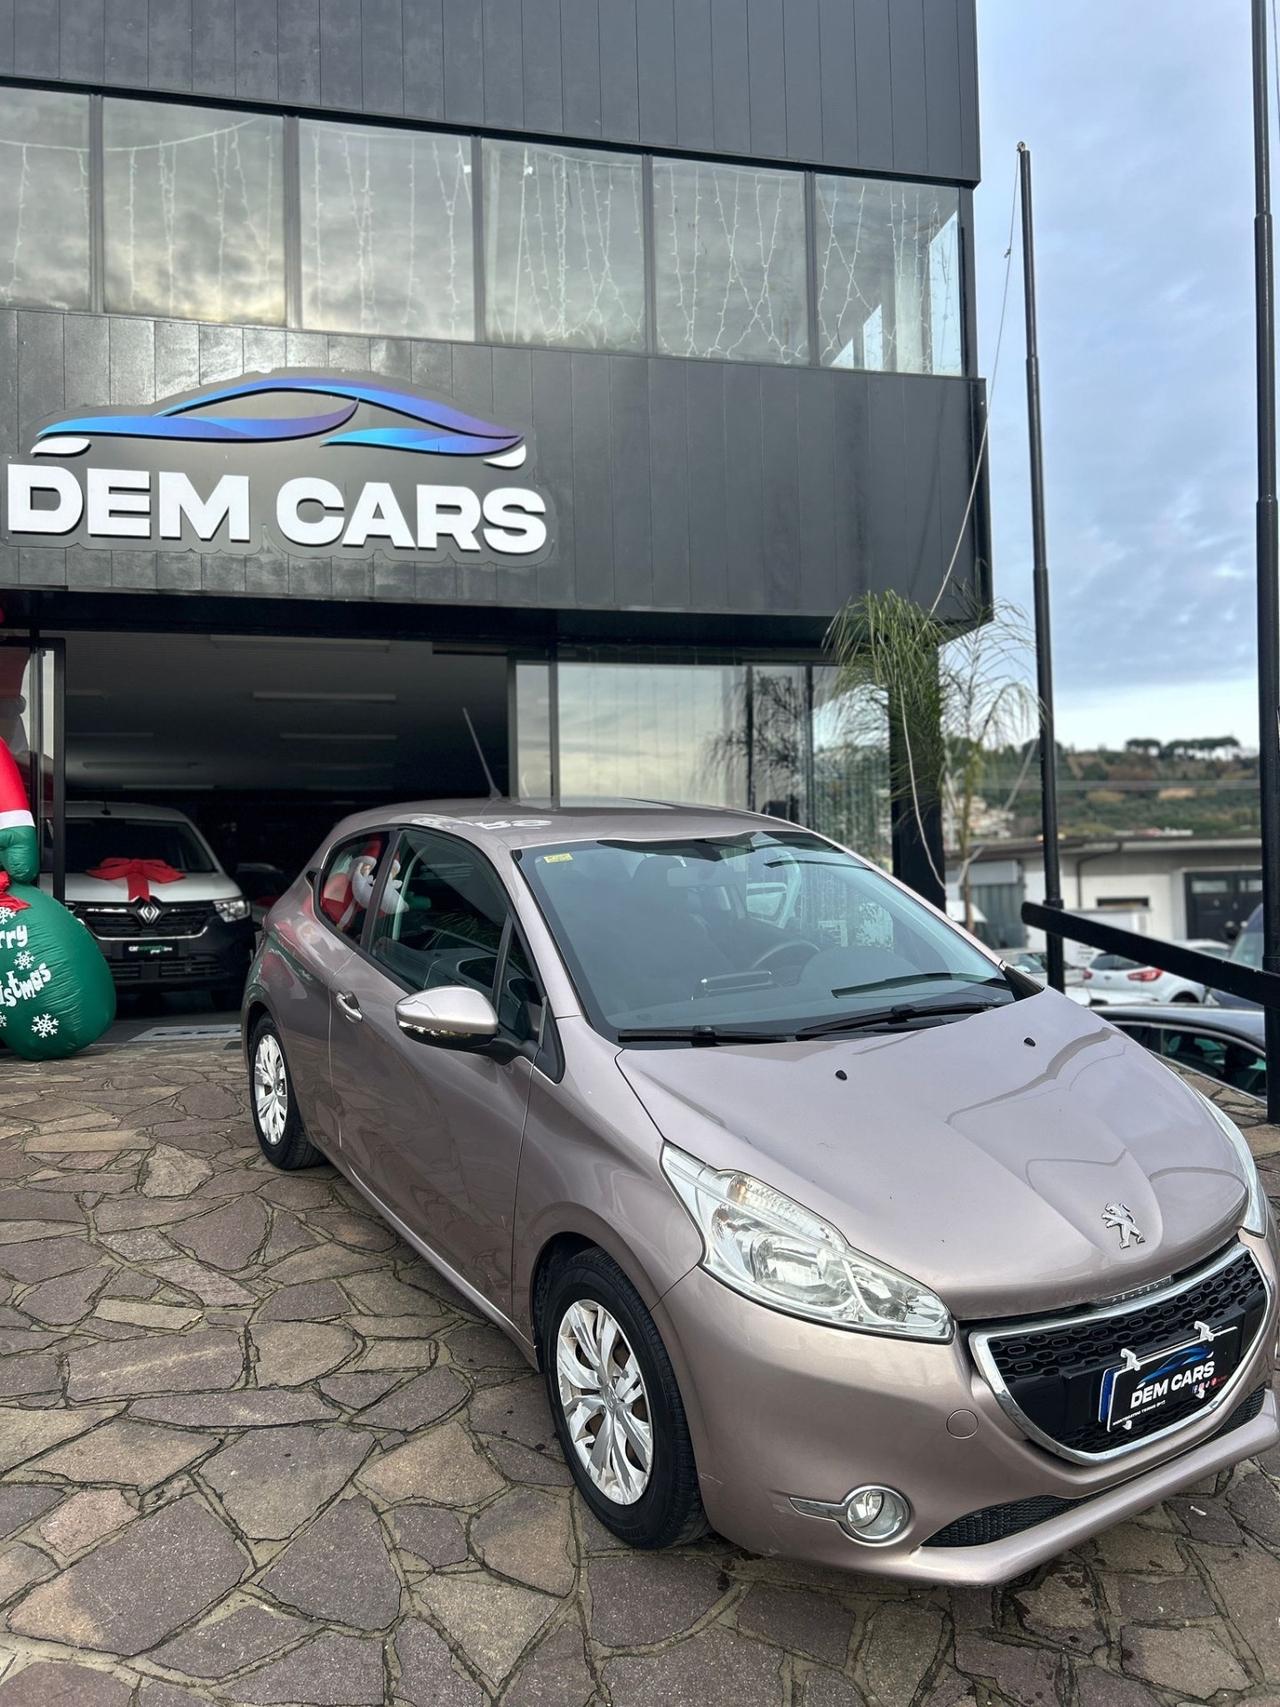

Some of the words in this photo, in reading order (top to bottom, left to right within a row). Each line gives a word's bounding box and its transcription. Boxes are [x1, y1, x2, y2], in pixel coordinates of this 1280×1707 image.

[7, 464, 250, 541] DEM
[276, 476, 547, 554] CARS
[1130, 1379, 1169, 1409] DEM
[1170, 1361, 1215, 1391] CARS
